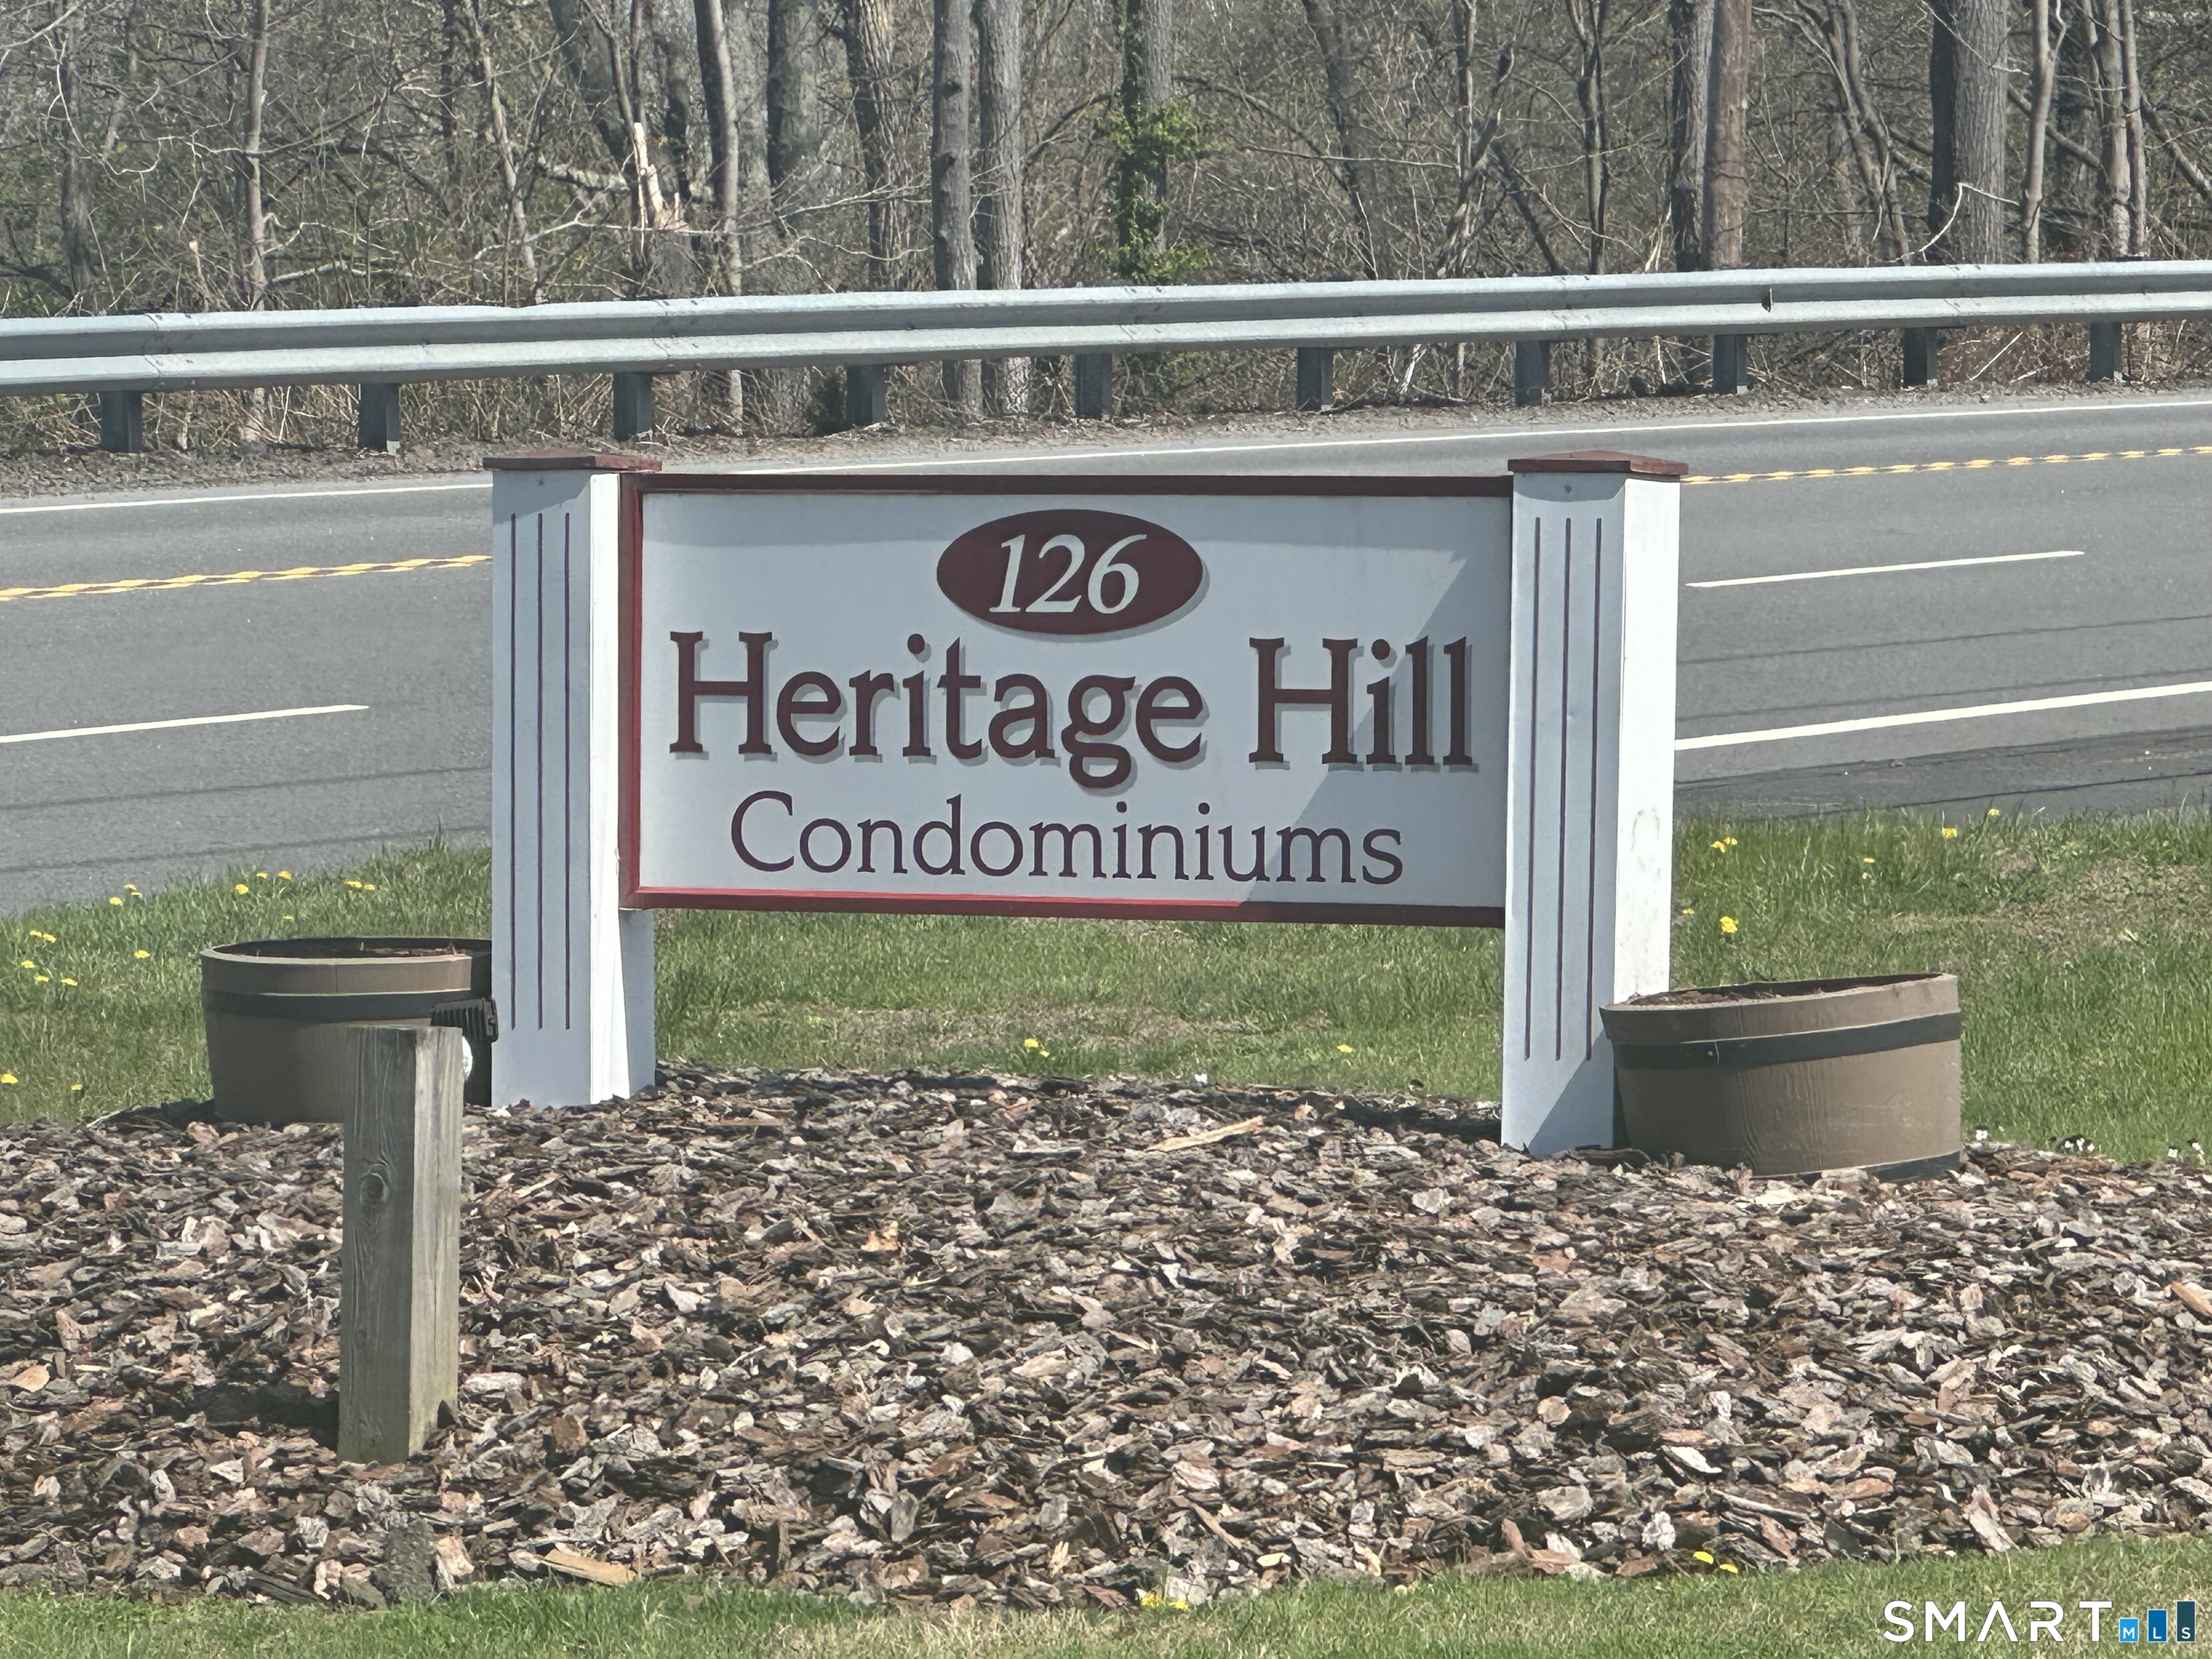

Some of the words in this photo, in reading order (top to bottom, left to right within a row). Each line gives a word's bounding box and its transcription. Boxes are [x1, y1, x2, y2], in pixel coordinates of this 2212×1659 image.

[989, 533, 1148, 614] 126
[669, 631, 1205, 788] Heritage
[1248, 635, 1474, 768] Hill
[731, 790, 1403, 885] Condominiums
